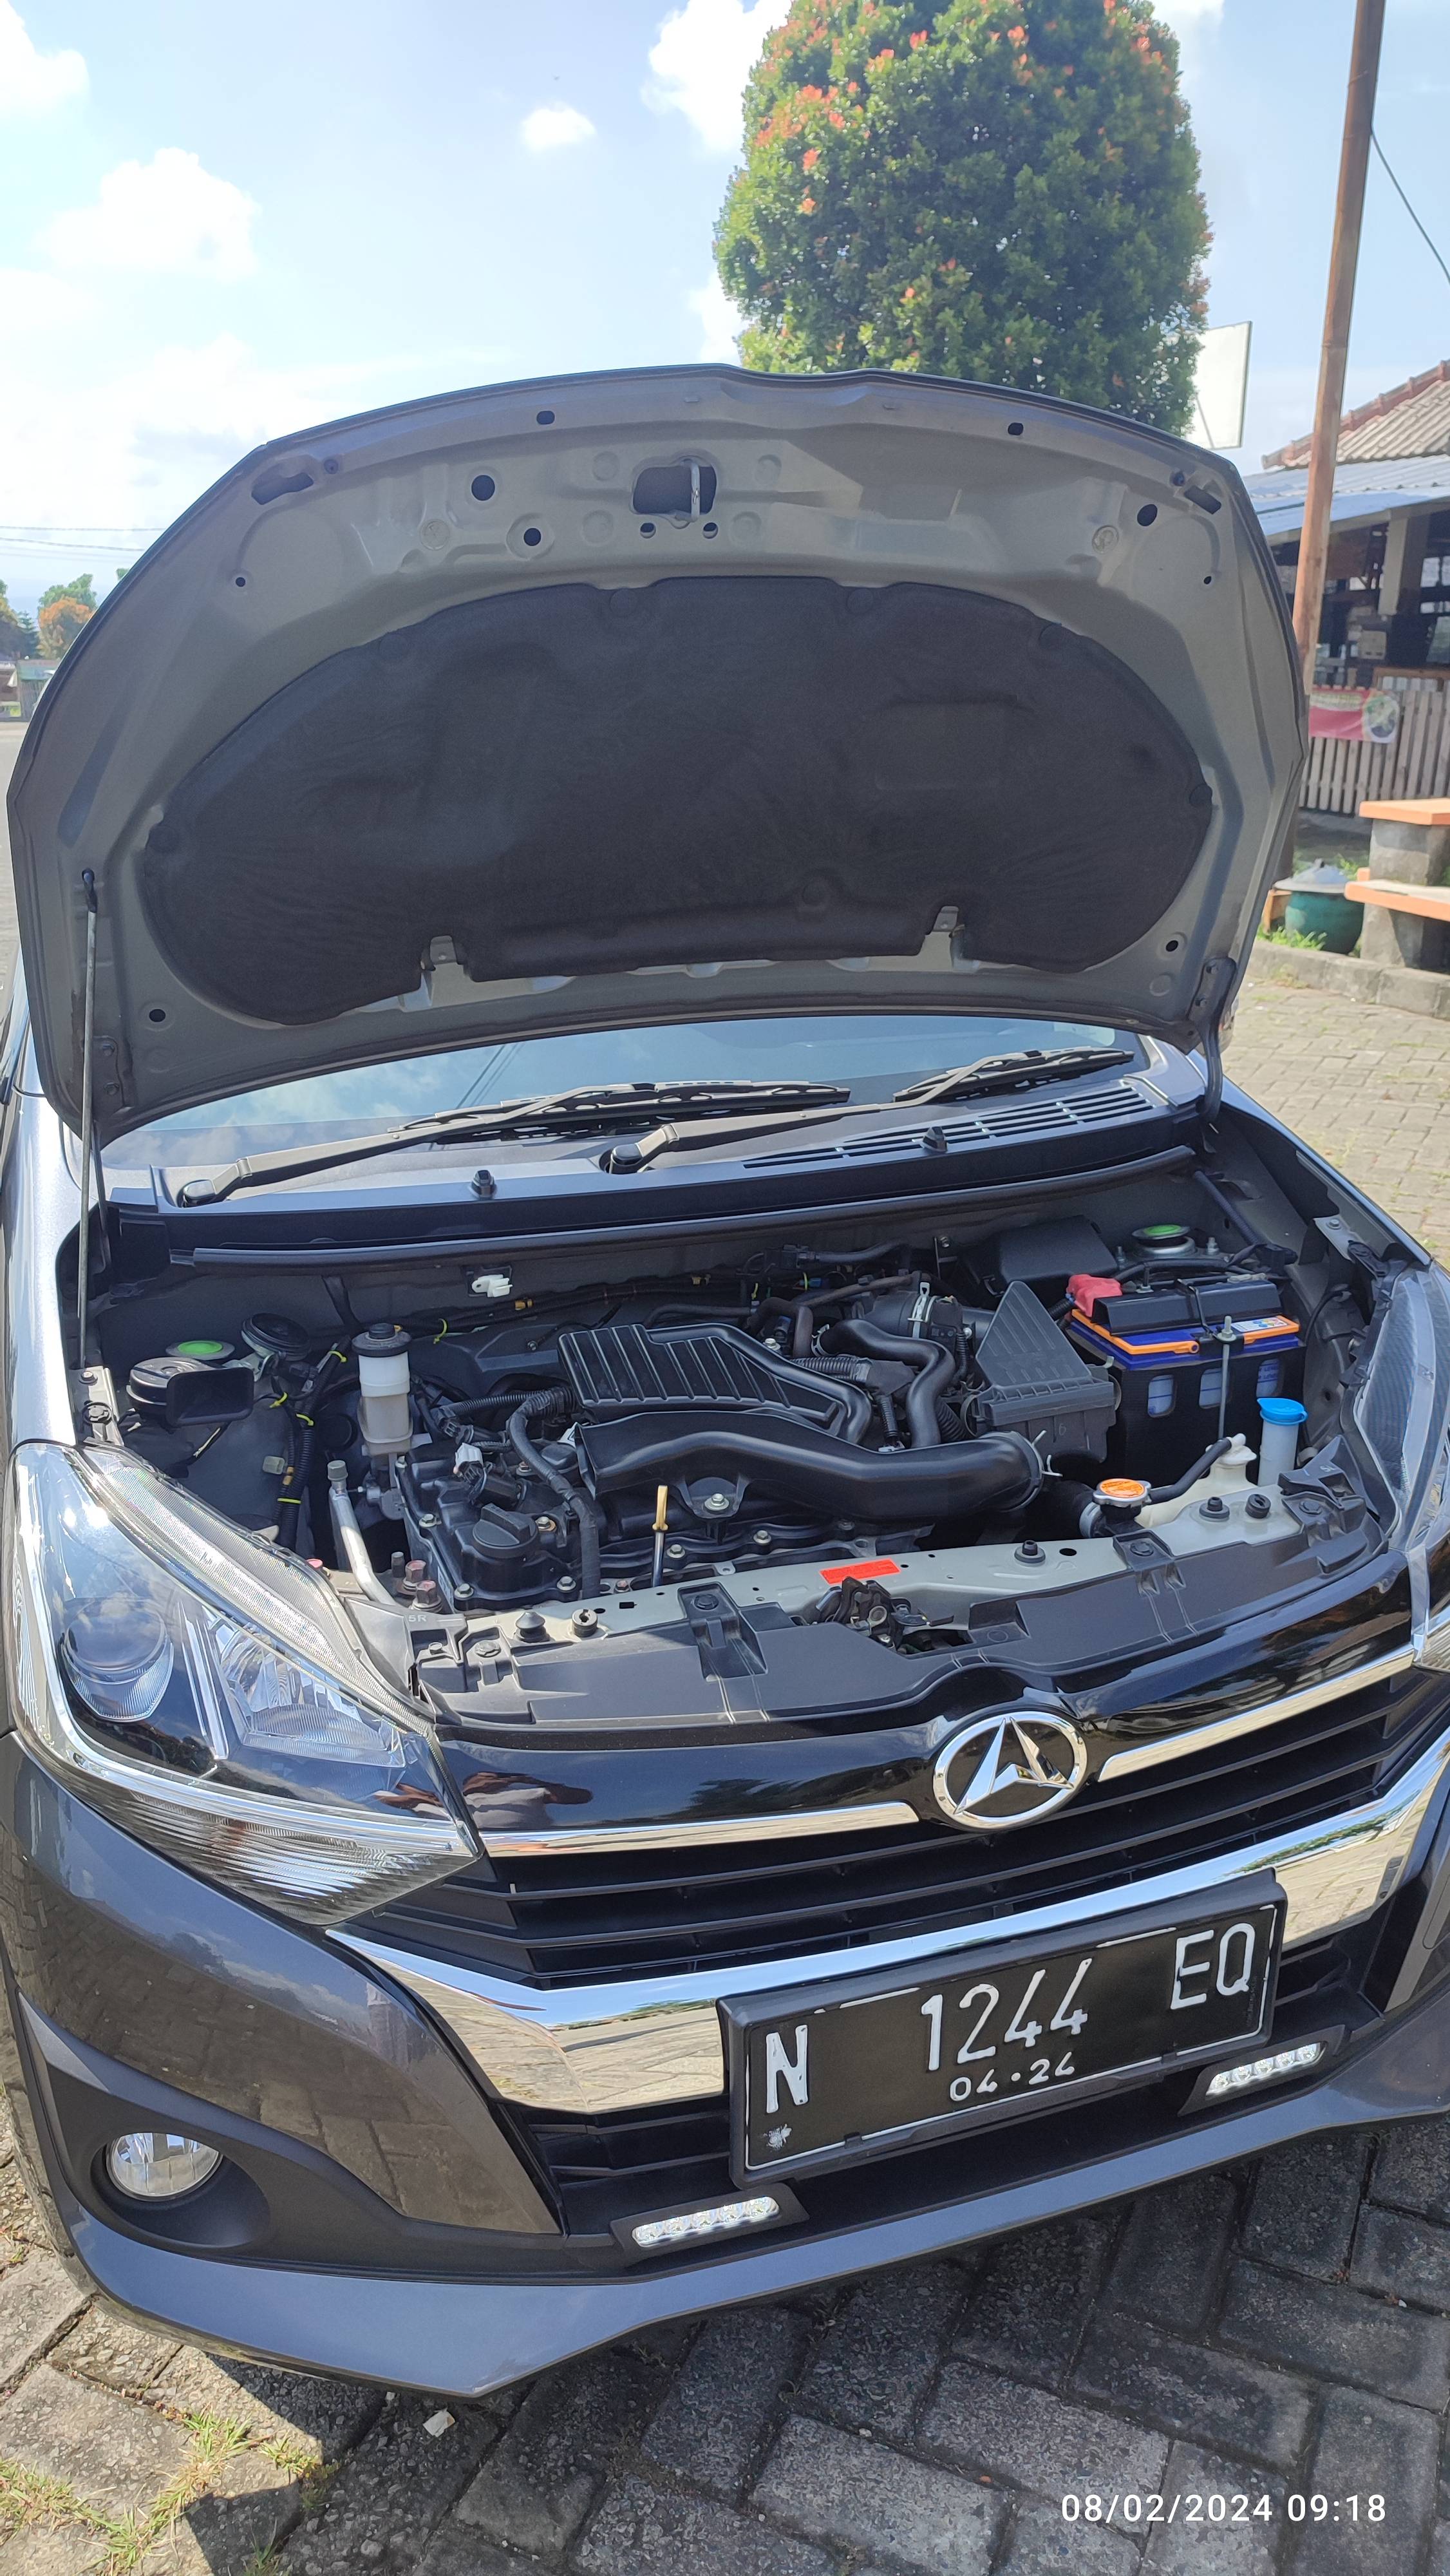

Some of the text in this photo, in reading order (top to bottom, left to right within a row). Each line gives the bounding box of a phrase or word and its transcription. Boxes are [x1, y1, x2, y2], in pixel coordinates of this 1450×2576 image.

[408, 1614, 426, 1622] 5R
[765, 2023, 809, 2114] N
[919, 1957, 1093, 2071] 1244
[1169, 1922, 1256, 2011] EQ
